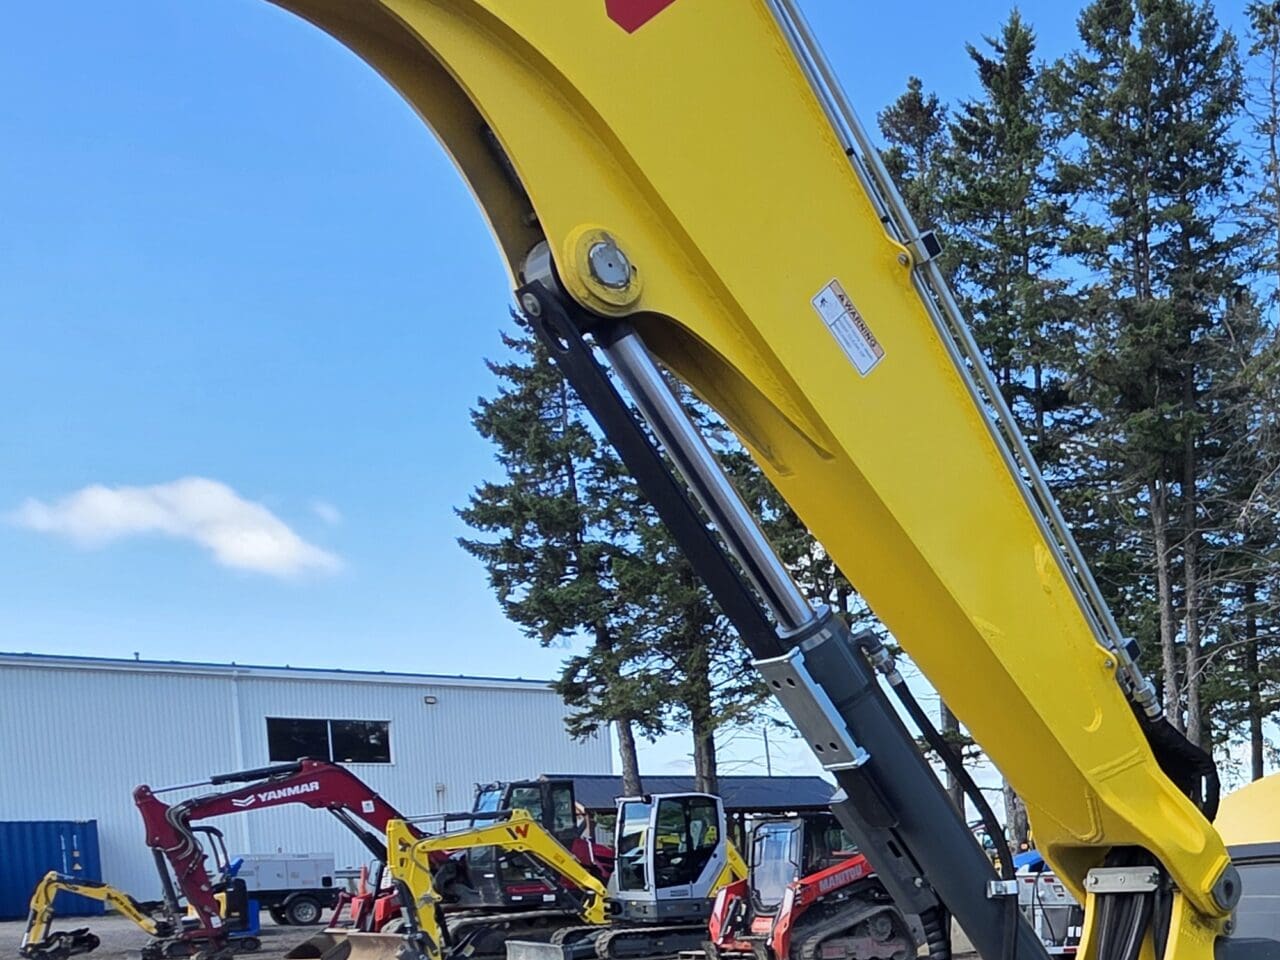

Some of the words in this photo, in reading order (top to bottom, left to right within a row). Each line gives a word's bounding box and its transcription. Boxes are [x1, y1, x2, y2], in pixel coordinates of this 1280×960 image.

[844, 300, 877, 348] WARNING
[257, 781, 320, 802] YANMAR
[819, 864, 863, 892] MANITOU
